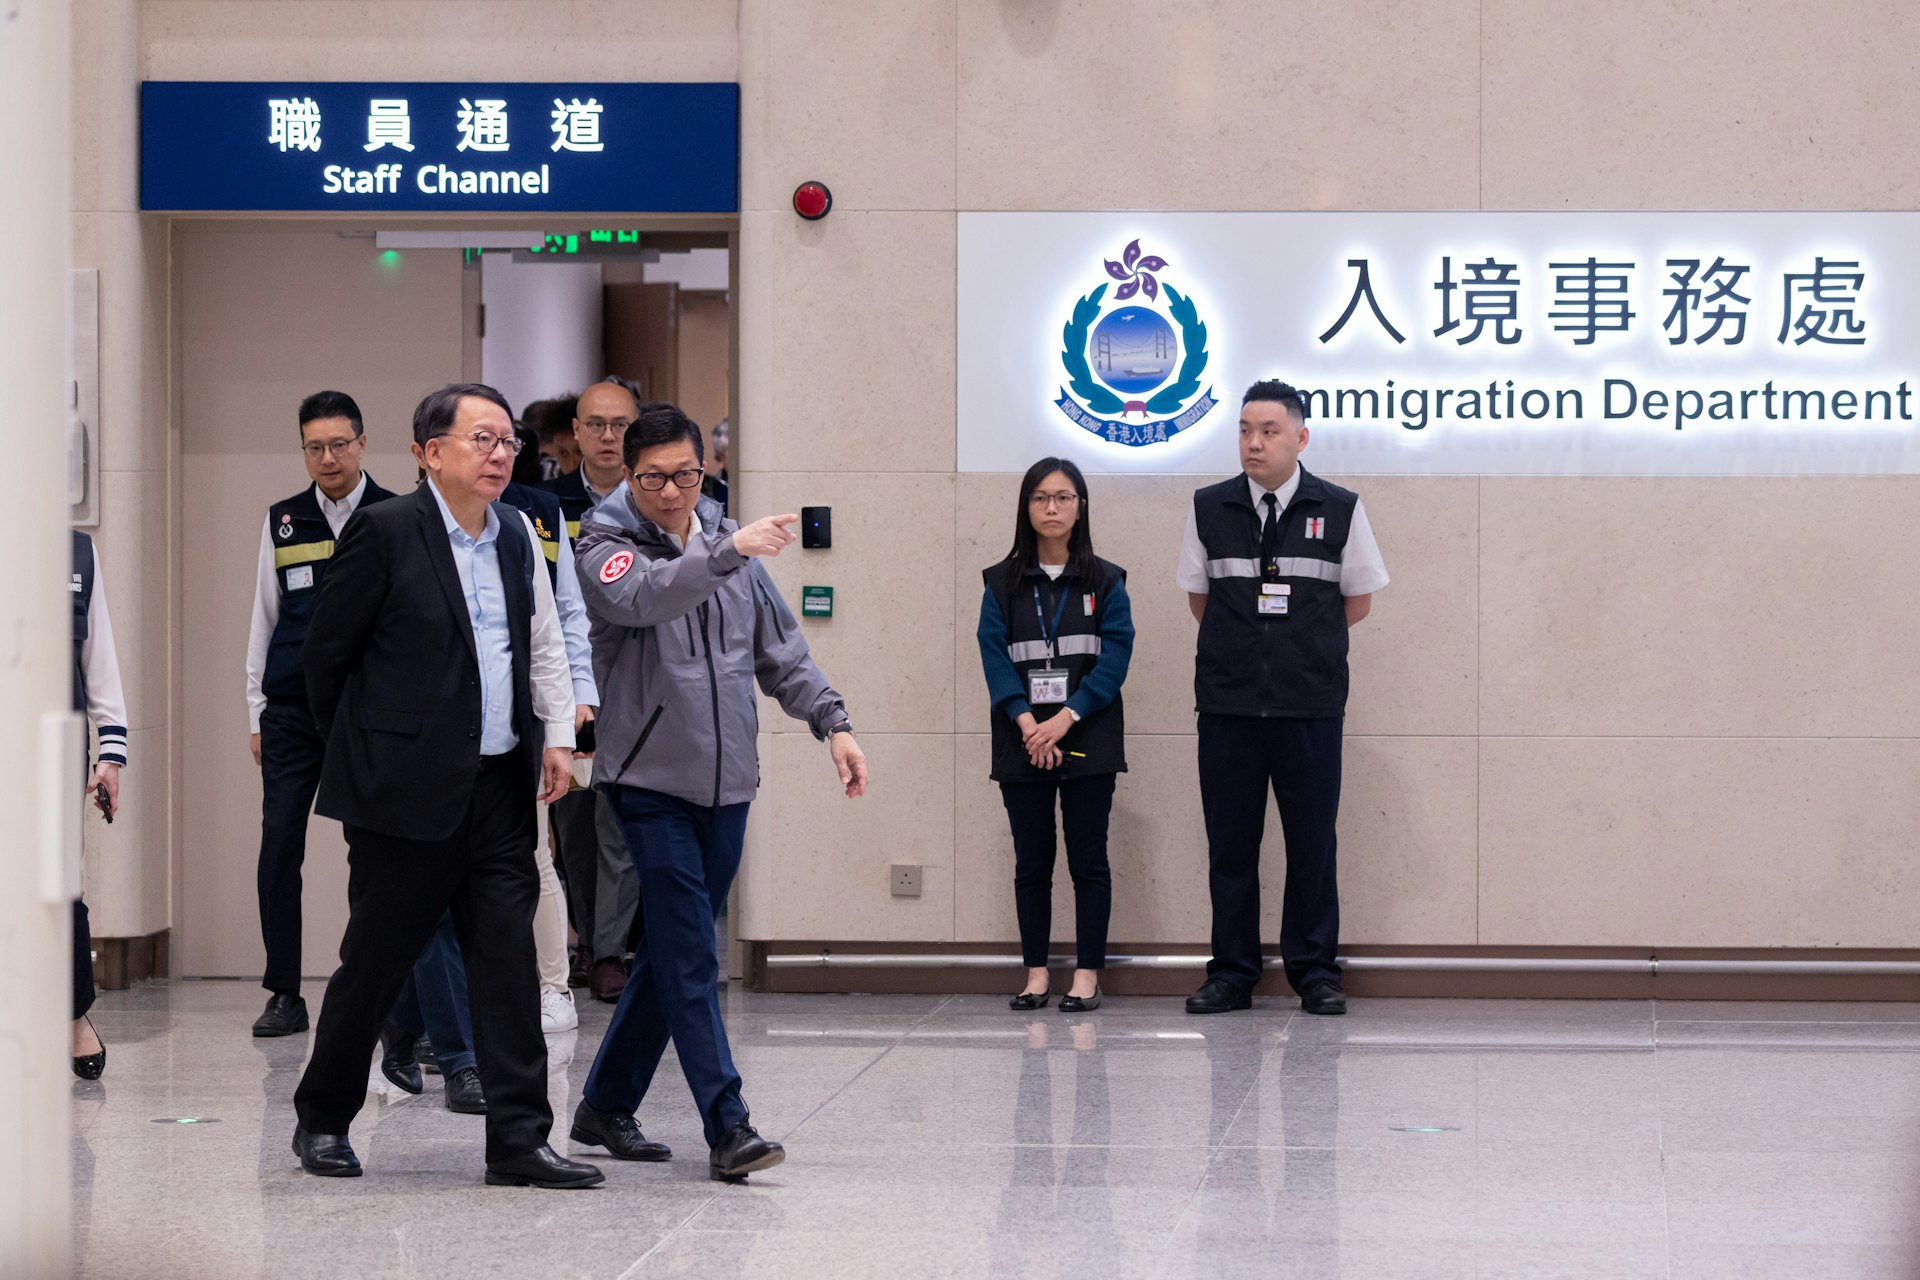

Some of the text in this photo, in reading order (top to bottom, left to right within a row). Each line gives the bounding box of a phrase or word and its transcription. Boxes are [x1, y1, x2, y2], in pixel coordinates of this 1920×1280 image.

[268, 97, 605, 153] 職員通道
[323, 164, 549, 194] Staff Channel
[1318, 256, 1867, 346] 入境事務處
[1060, 398, 1102, 433] HONG KONG
[1271, 378, 1913, 431] mmigration Department
[1106, 421, 1168, 444] 香港入境處
